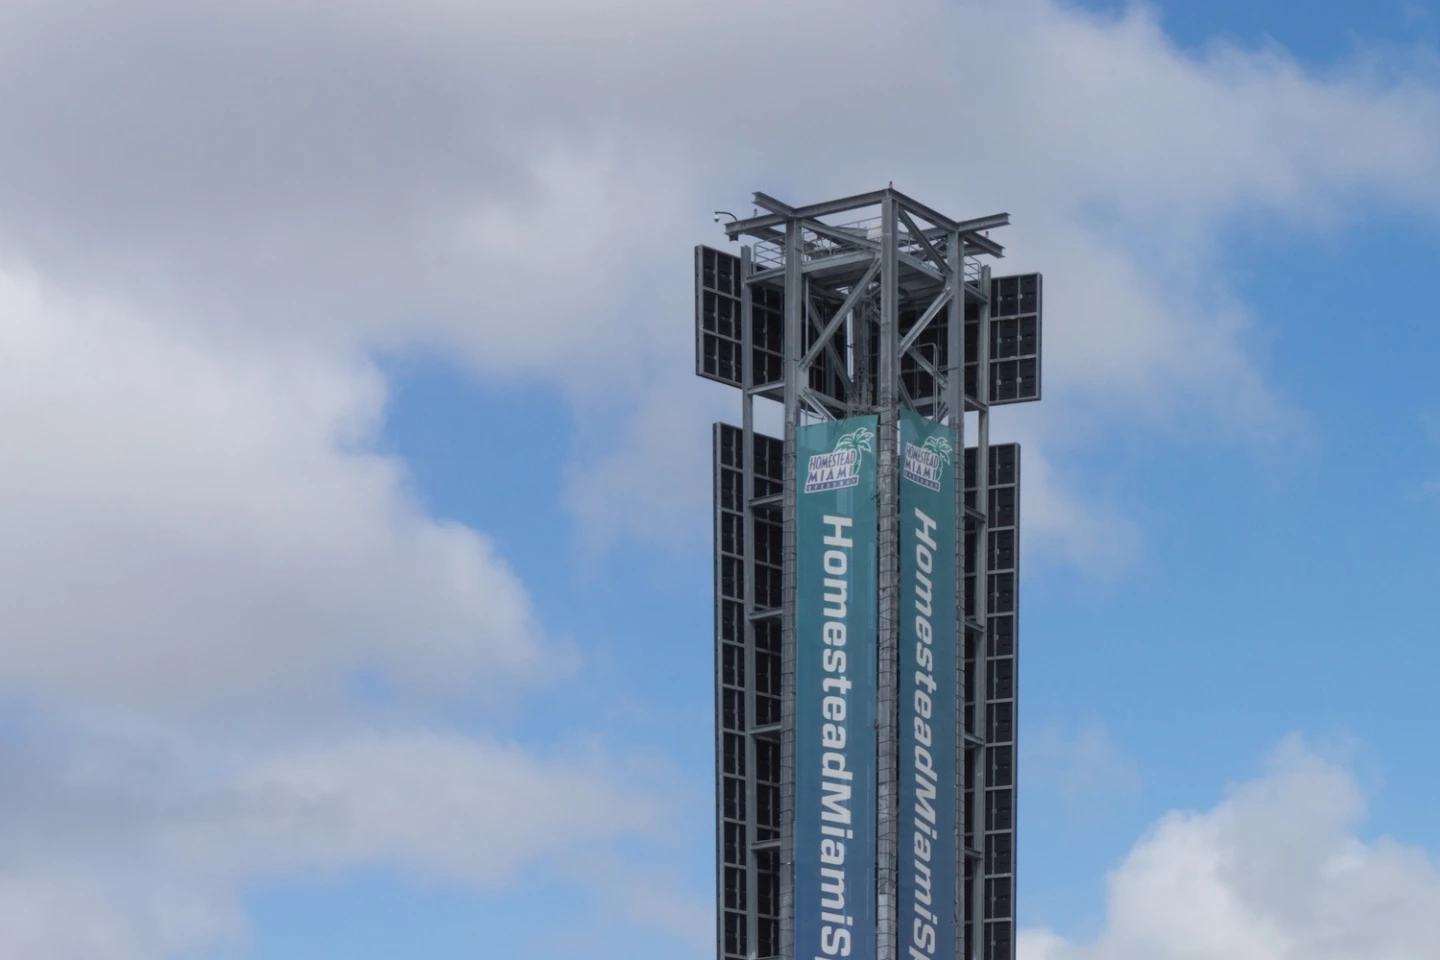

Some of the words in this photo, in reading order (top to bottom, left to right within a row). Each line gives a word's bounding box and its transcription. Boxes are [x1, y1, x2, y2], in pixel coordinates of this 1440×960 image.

[808, 449, 857, 471] HOMESTEAD
[904, 459, 937, 481] MIAMI
[807, 464, 853, 484] MIAMI
